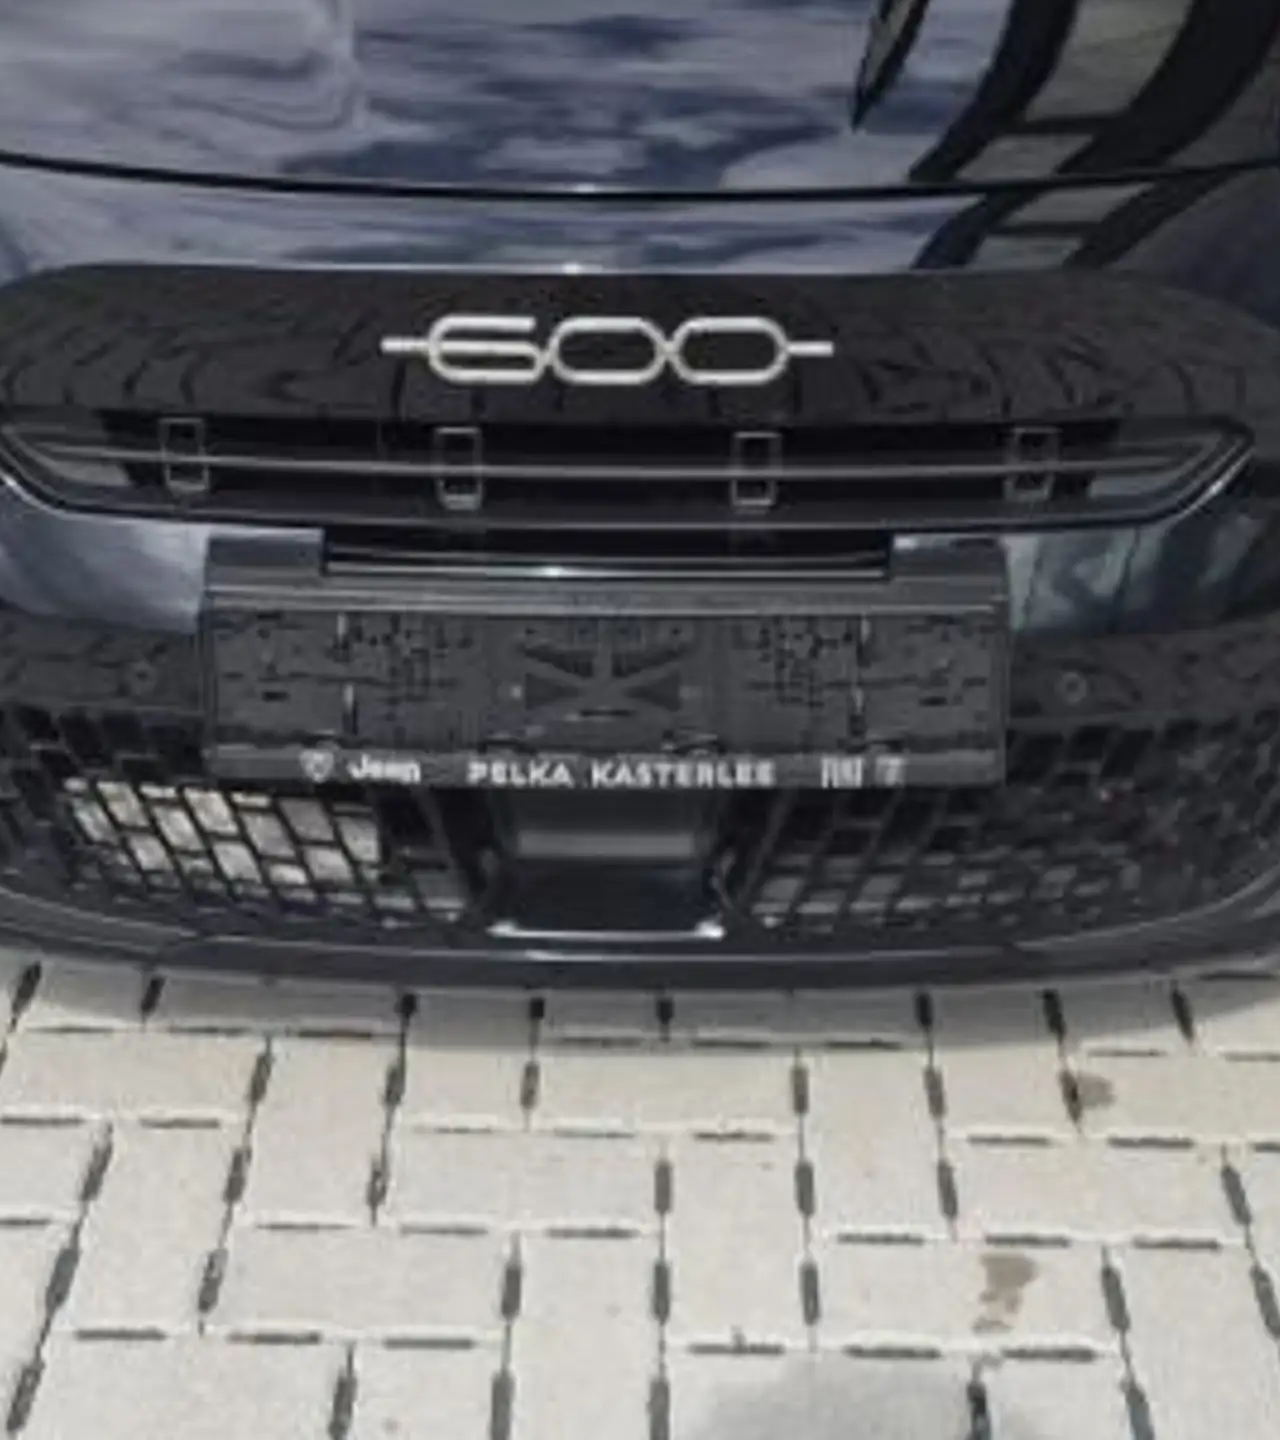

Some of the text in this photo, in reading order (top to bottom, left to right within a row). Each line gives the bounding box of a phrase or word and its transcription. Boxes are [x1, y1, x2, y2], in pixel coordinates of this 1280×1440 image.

[381, 315, 833, 385] 600
[467, 759, 775, 788] PELKA KASTERLEE
